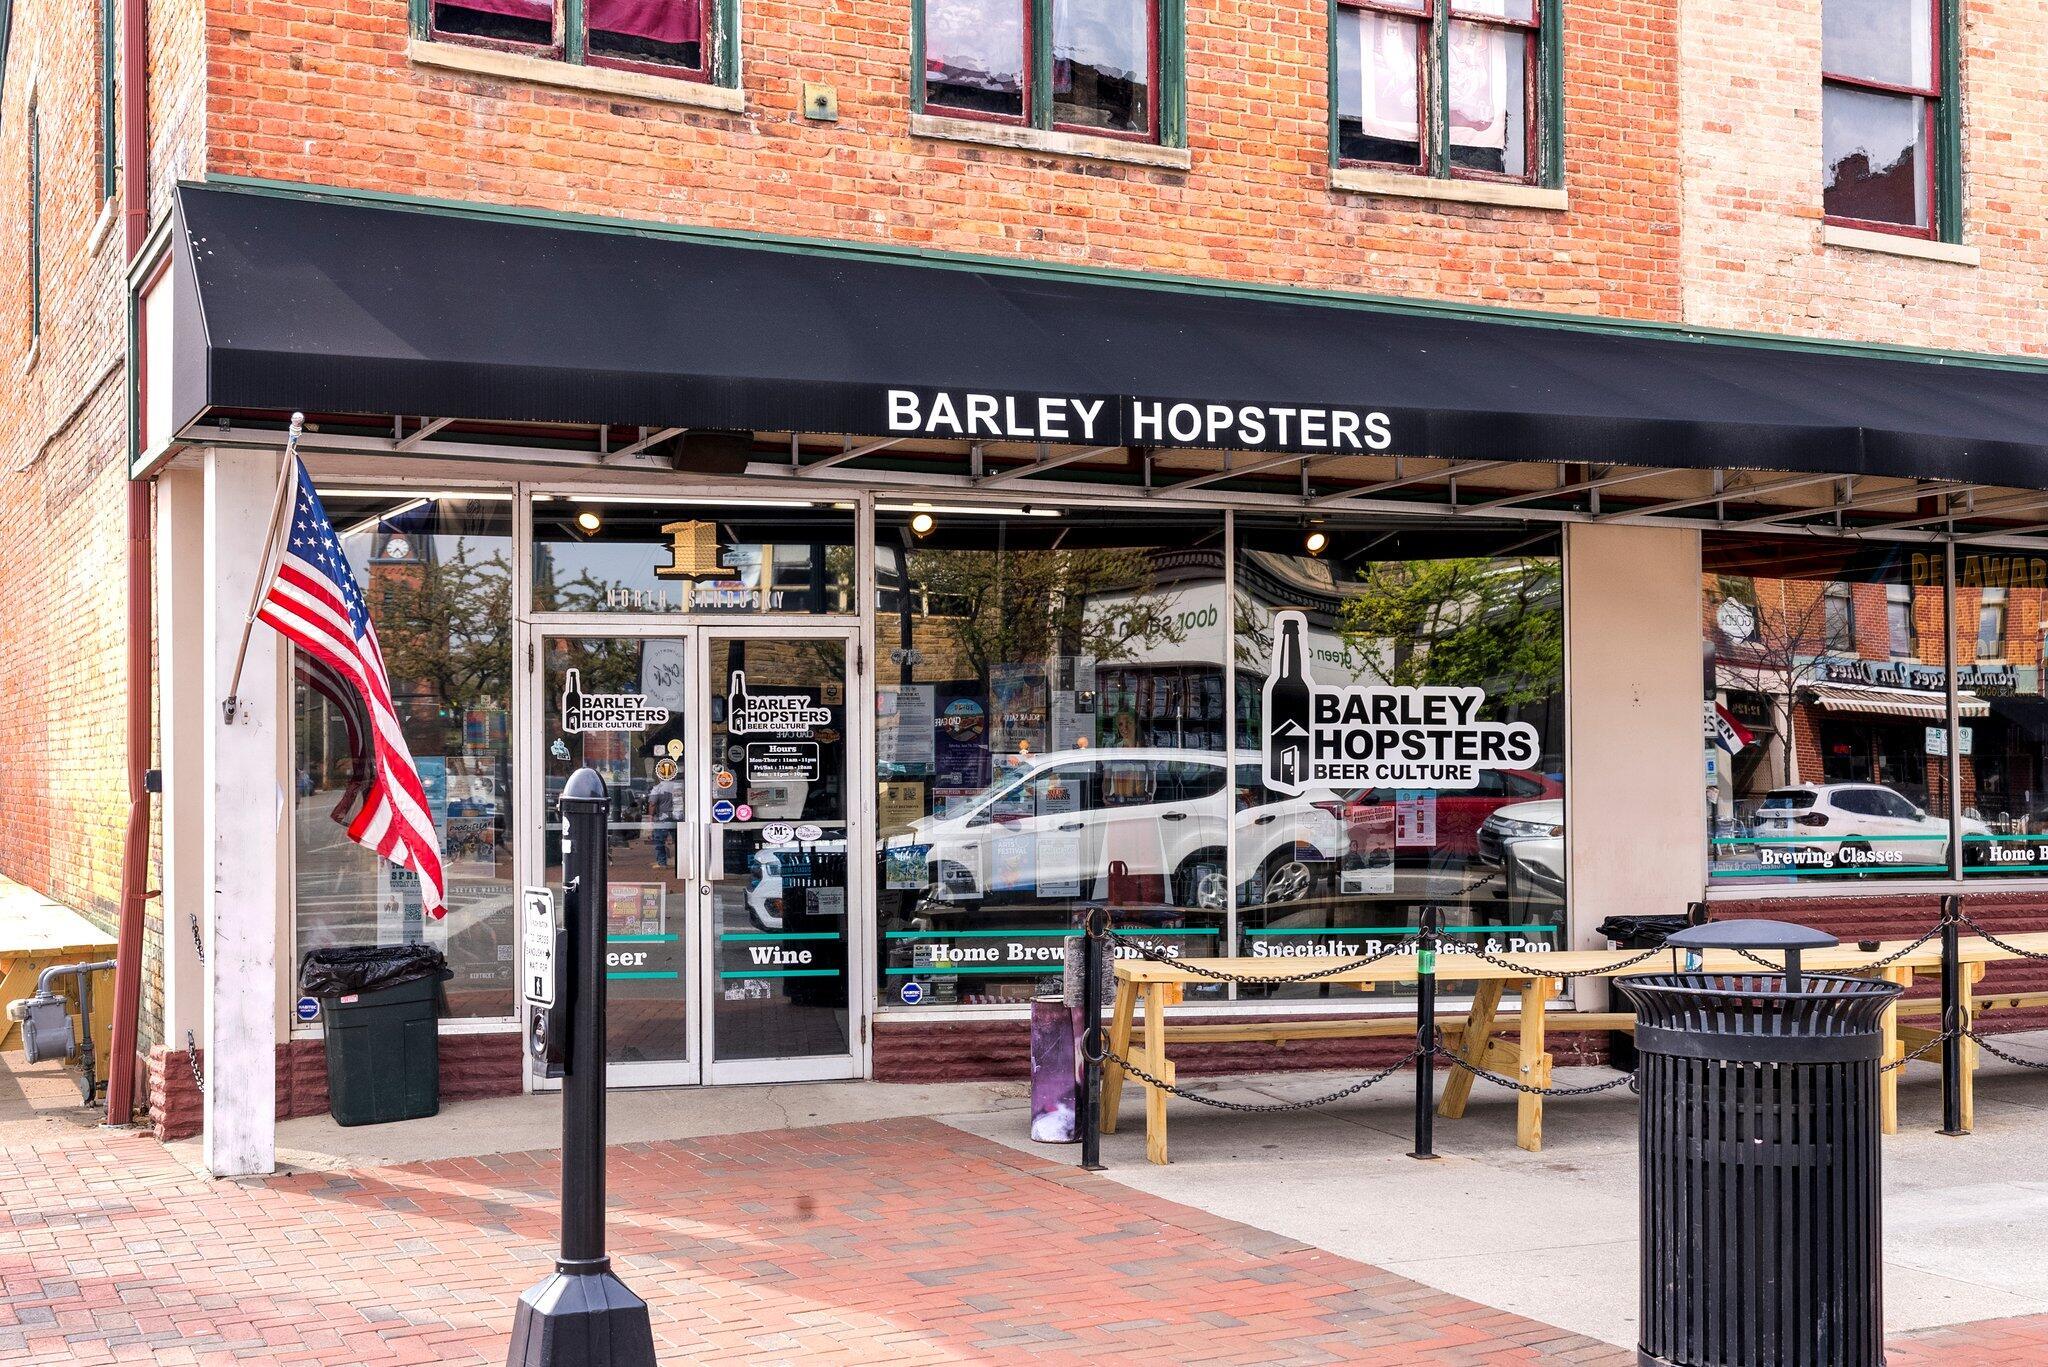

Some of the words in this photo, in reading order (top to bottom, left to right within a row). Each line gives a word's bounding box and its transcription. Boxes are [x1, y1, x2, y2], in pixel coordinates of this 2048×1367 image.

[887, 389, 1104, 439] BARLEY
[1133, 401, 1392, 449] HOPSTERS
[1911, 552, 2048, 589] DEAWAR
[607, 589, 667, 608] NORTH
[688, 589, 784, 609] SANDUSKY
[582, 697, 644, 708] BARLEY
[747, 699, 808, 710] BARLEY
[1314, 693, 1477, 726] BARLEY
[582, 710, 666, 721] HOPSTERS
[747, 711, 829, 722] HOPSTERS
[769, 745, 797, 753] Hours
[1314, 729, 1532, 761] HOPSTERS
[1314, 763, 1369, 780] BEER
[1375, 763, 1472, 780] CULTURE
[1761, 848, 1834, 867] Brewing
[1839, 846, 1903, 863] Classes
[1989, 846, 2034, 861] Home
[749, 946, 813, 965] Wine
[929, 944, 999, 962] Home
[1253, 940, 1359, 958] Specialty
[606, 951, 648, 966] eer
